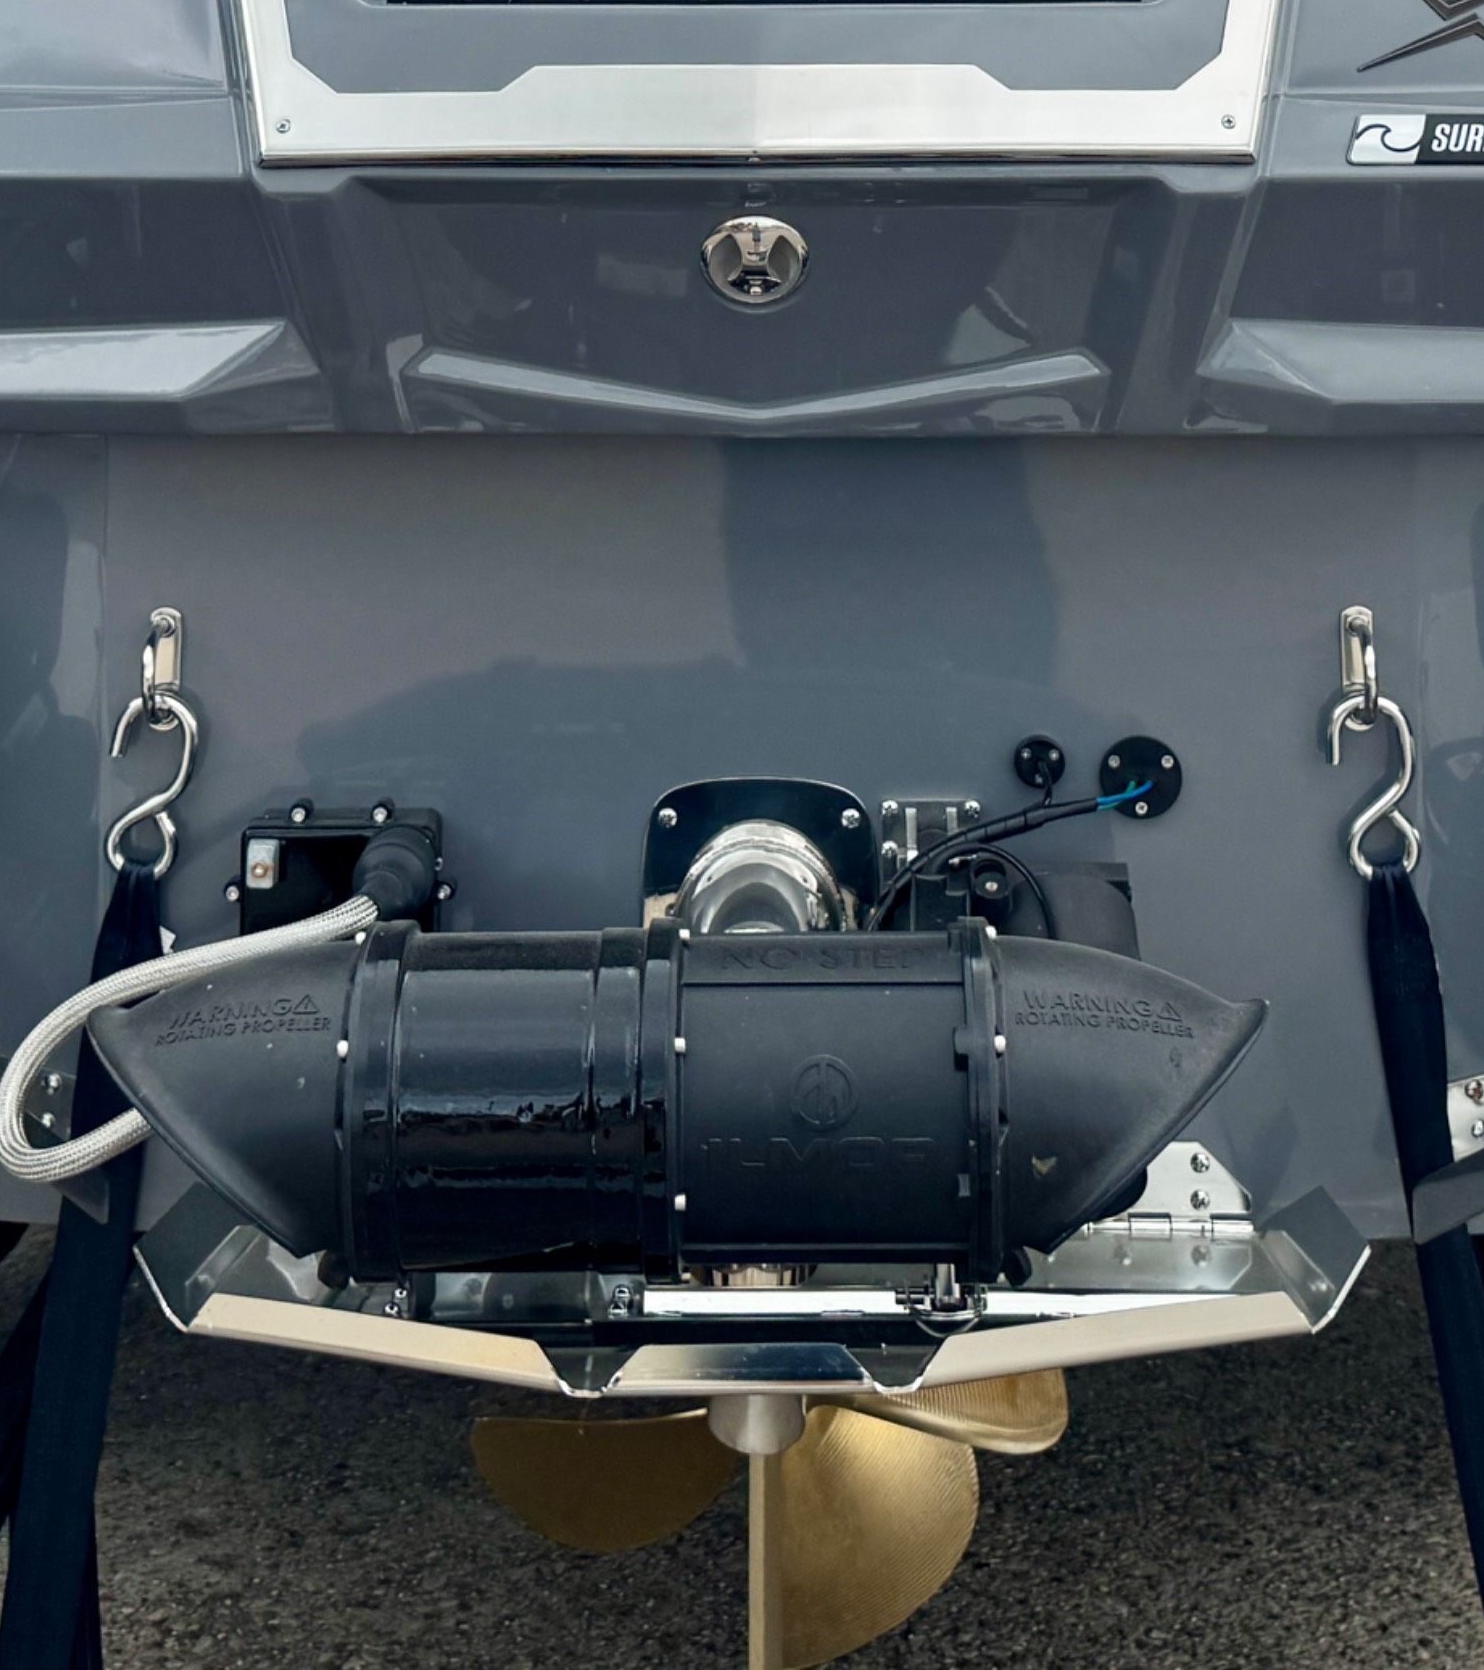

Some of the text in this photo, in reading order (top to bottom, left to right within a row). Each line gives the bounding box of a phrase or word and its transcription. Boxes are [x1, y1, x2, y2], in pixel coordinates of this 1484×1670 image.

[169, 998, 292, 1030] WARNING
[1023, 990, 1153, 1018] WARNING
[155, 1017, 332, 1047] ROTATING PROPELLER
[1015, 1011, 1195, 1039] ROTATING PROPELLER
